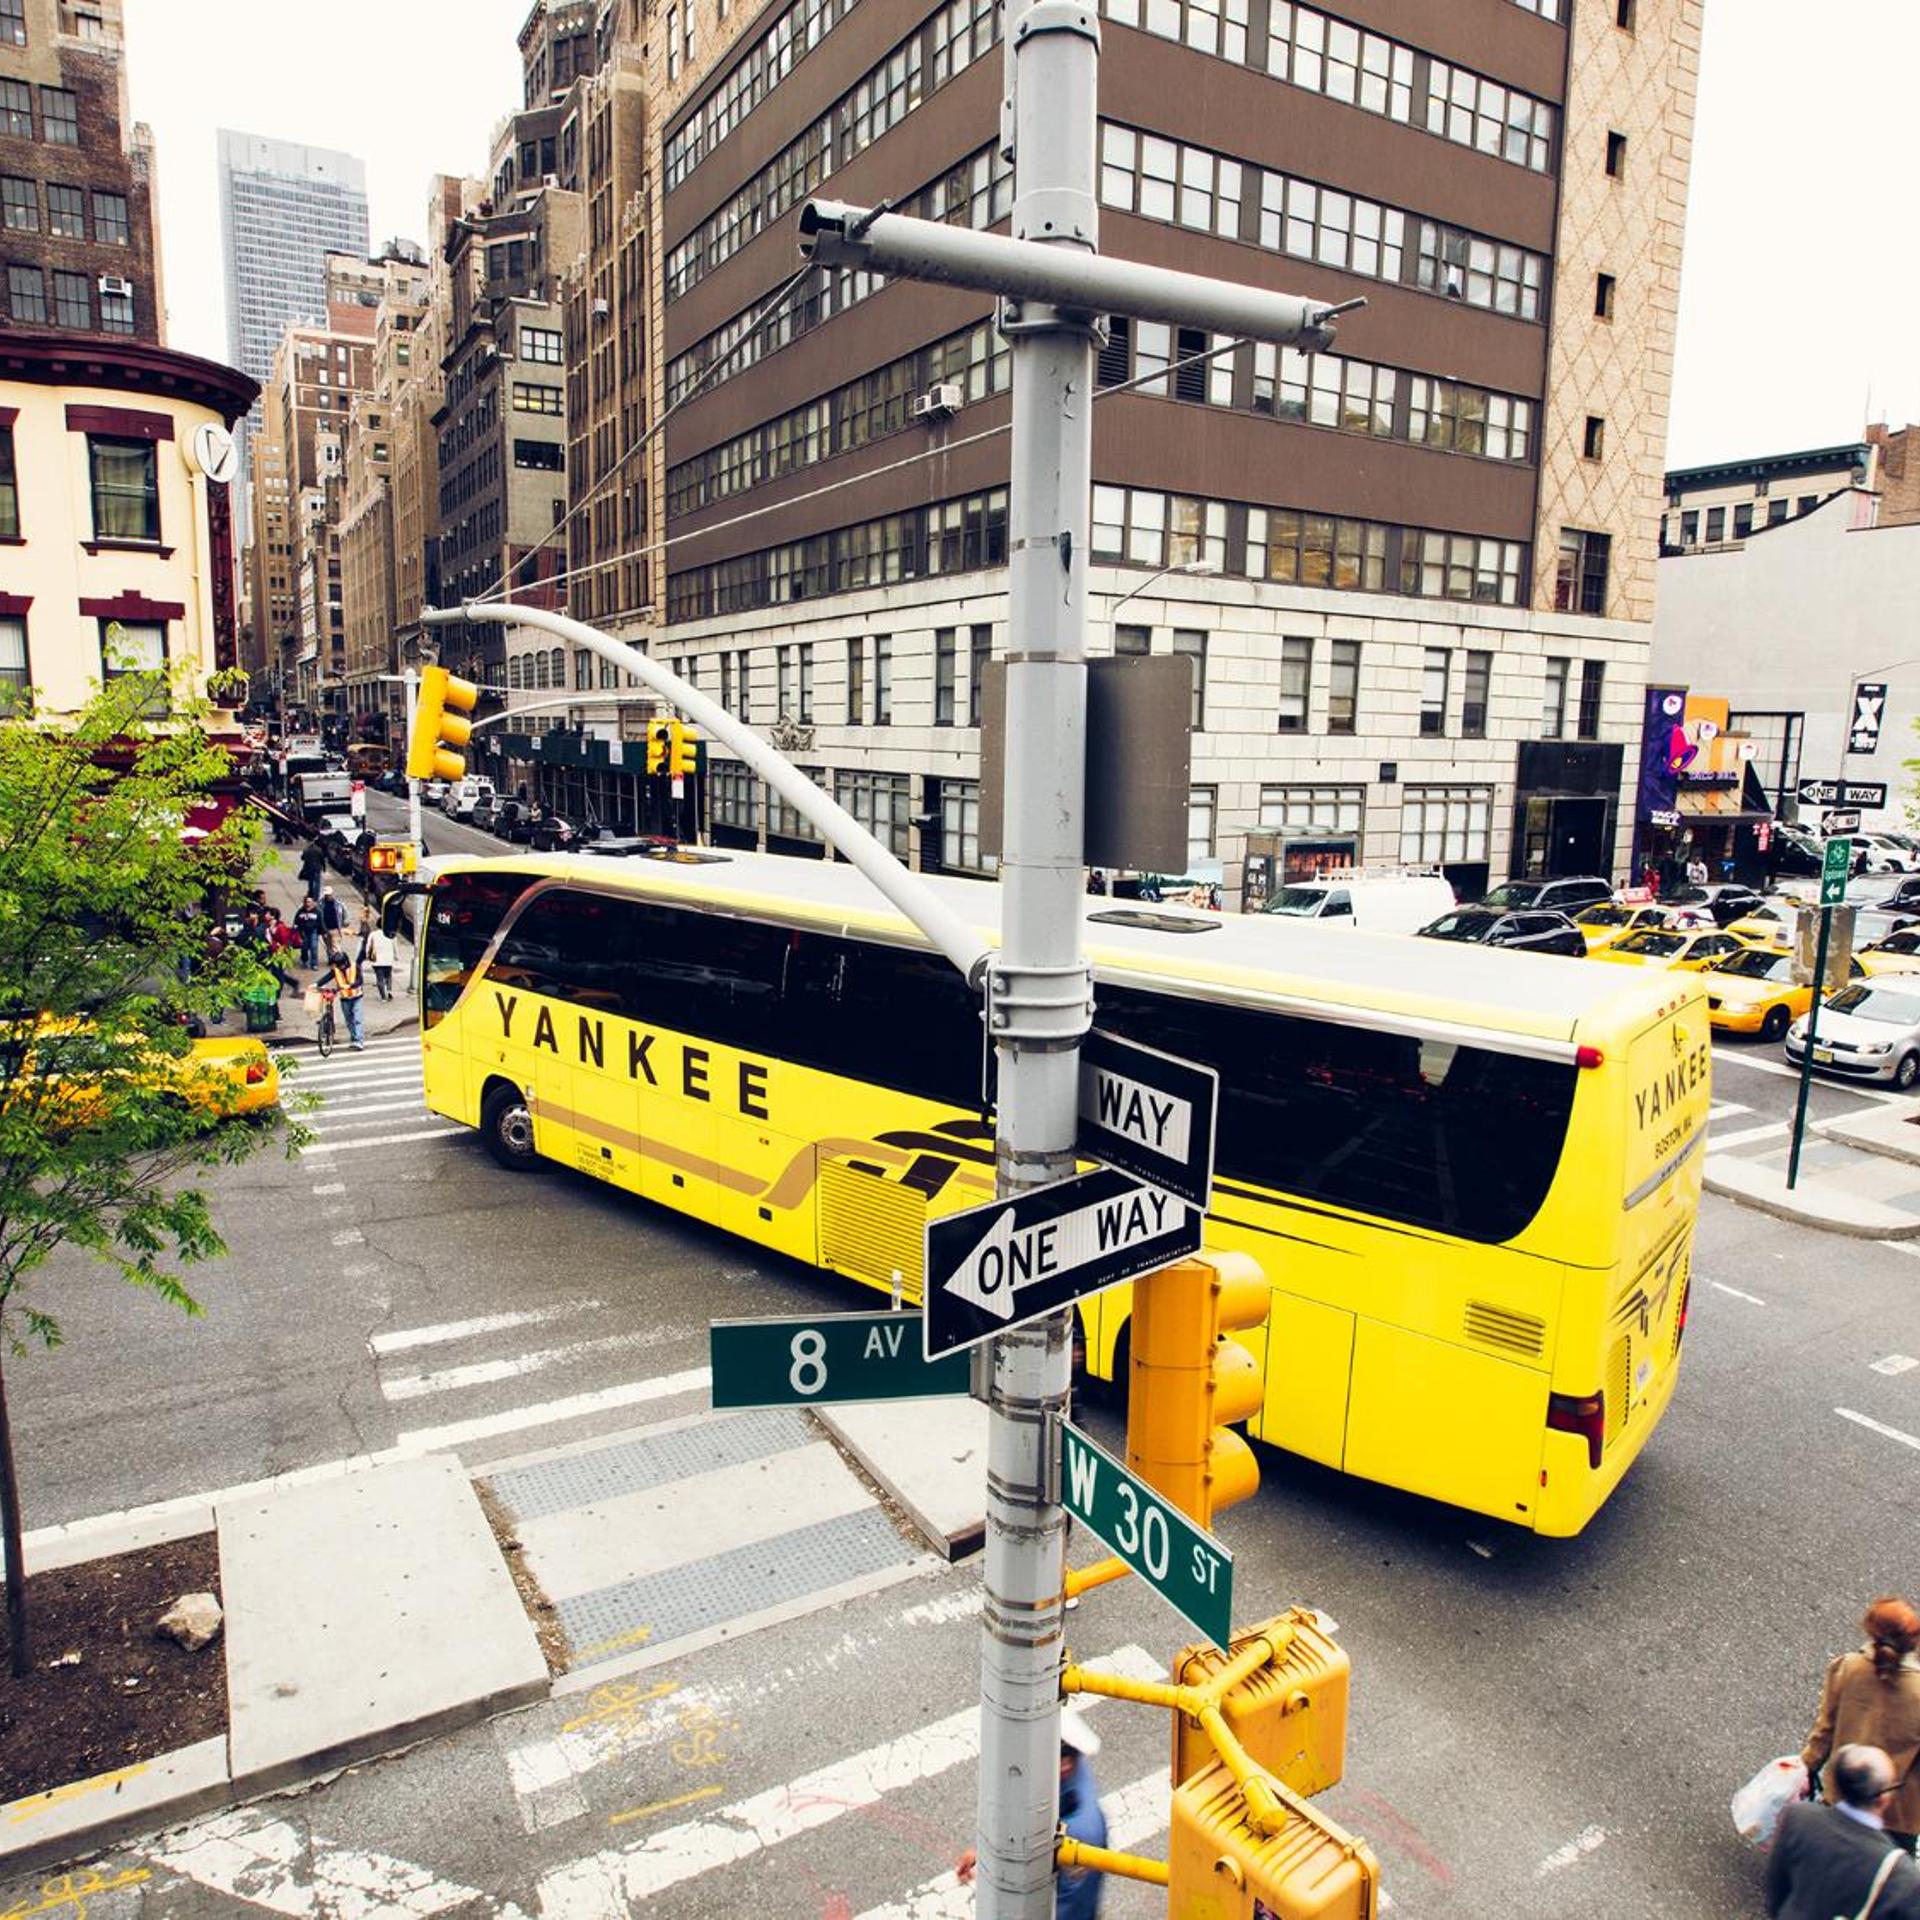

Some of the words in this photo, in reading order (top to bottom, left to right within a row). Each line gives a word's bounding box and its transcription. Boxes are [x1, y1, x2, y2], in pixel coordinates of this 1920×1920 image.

[1651, 810, 1681, 819] TACO
[1651, 817, 1680, 827] BELL
[1806, 787, 1836, 799] ONE
[1849, 789, 1879, 801] WAY
[495, 991, 769, 1121] YANKEE
[1635, 1043, 1706, 1131] YANKEE
[1099, 1074, 1174, 1147] WAY
[978, 1224, 1058, 1295] ONE
[1097, 1191, 1168, 1251] WAY
[789, 1329, 828, 1396] 8
[863, 1325, 905, 1360] AV
[1068, 1437, 1098, 1517] W
[1115, 1481, 1170, 1581] 30
[1191, 1543, 1221, 1595] ST
